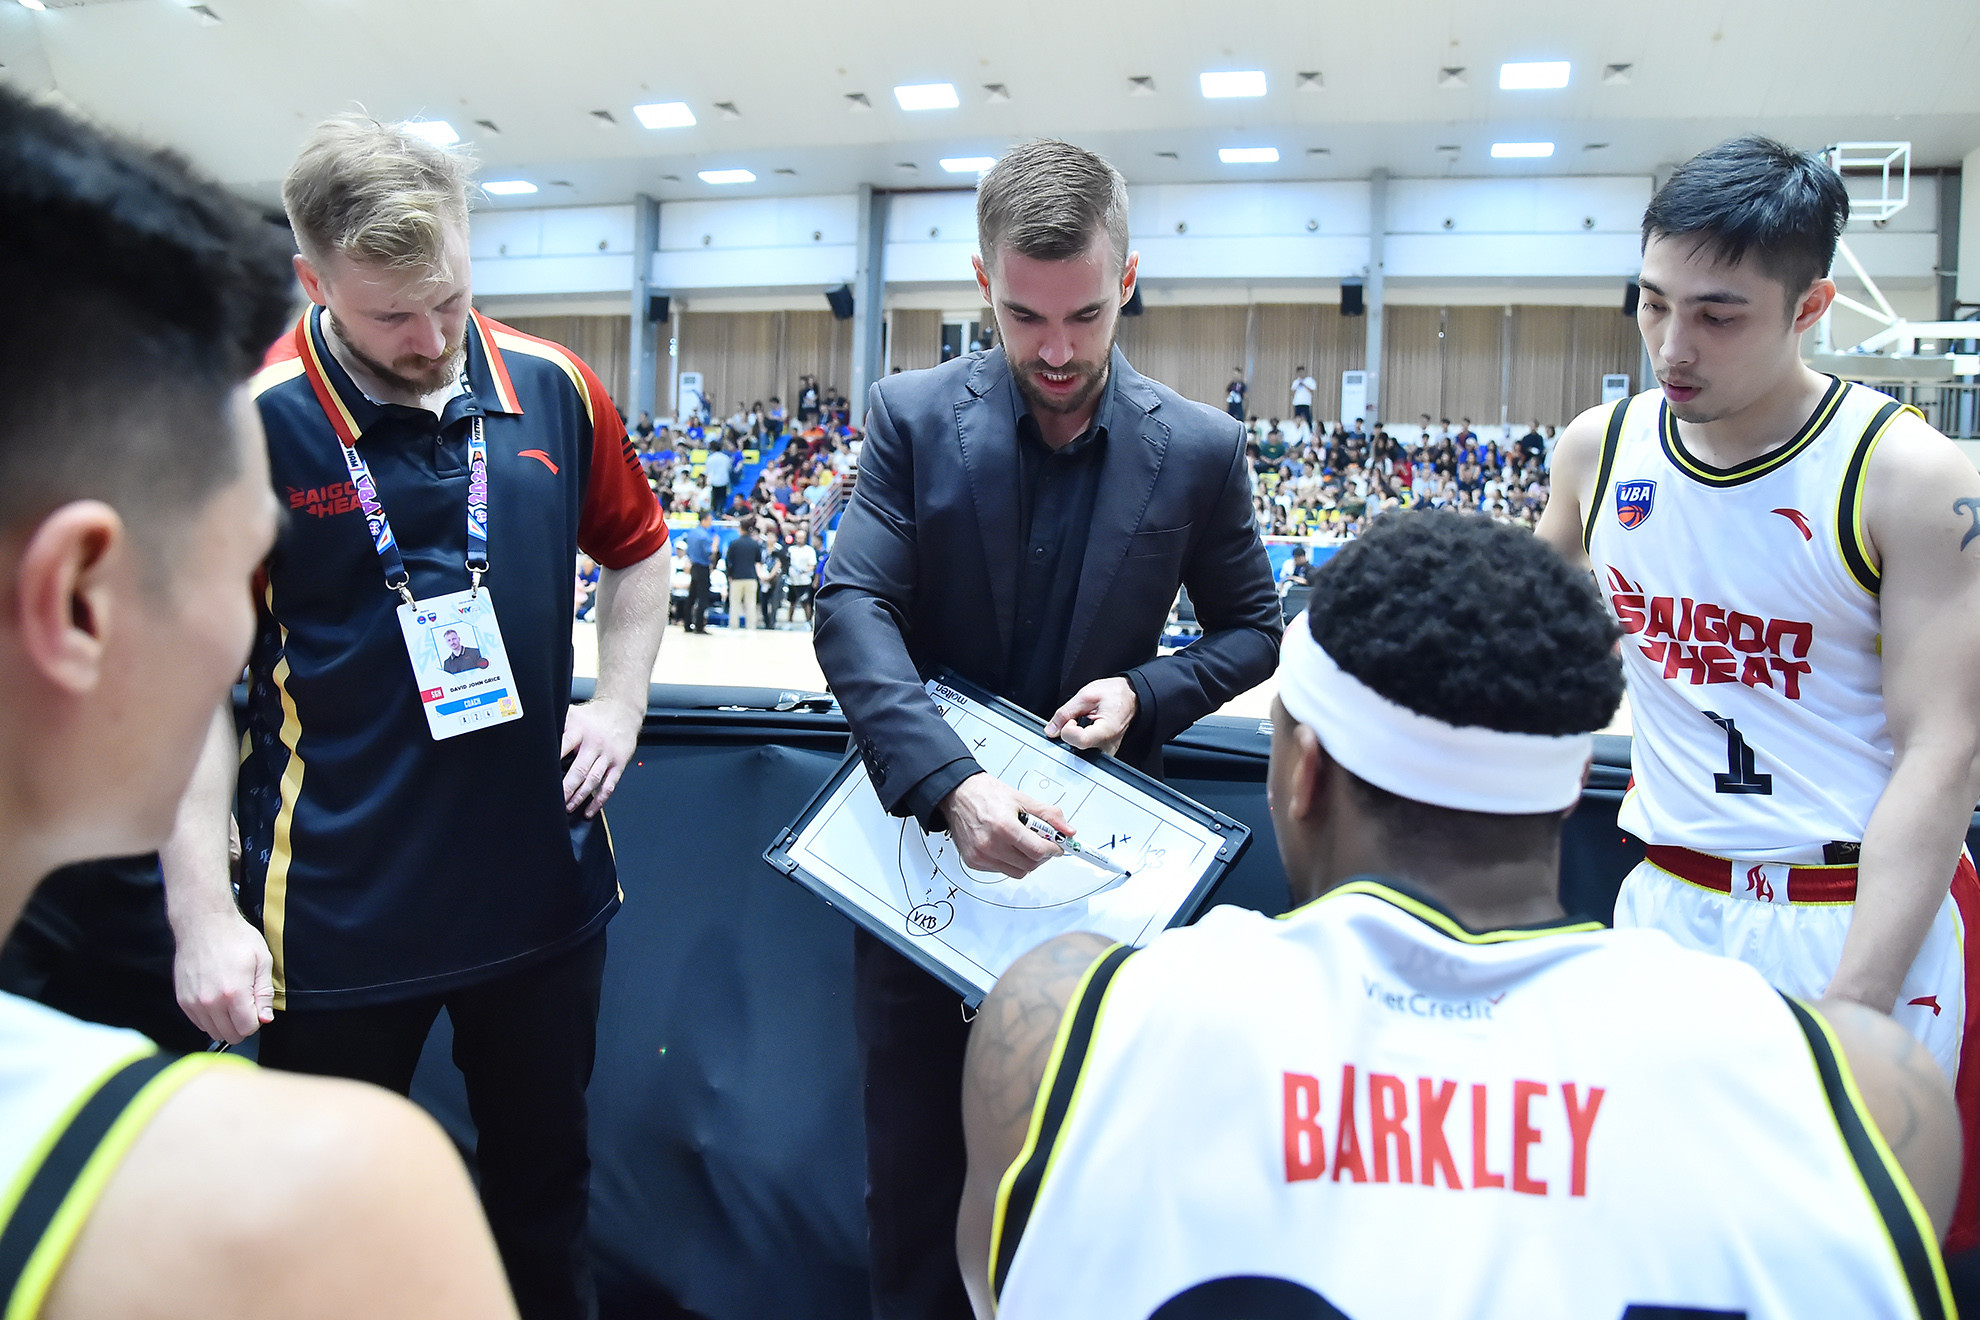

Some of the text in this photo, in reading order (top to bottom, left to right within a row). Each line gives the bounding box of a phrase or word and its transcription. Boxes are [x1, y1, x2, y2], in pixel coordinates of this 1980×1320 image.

[289, 481, 357, 509] SAIGO
[357, 475, 382, 516] VBA
[467, 460, 488, 506] 2023
[318, 495, 362, 518] HEA
[1611, 594, 1813, 658] SAIGON
[450, 676, 501, 693] DAVID JOHN GRICE
[1661, 642, 1813, 700] HEAT
[463, 697, 482, 708] COACH
[935, 684, 968, 705] molten
[1701, 710, 1774, 796] 1
[1283, 1064, 1606, 1197] BARKLEY
